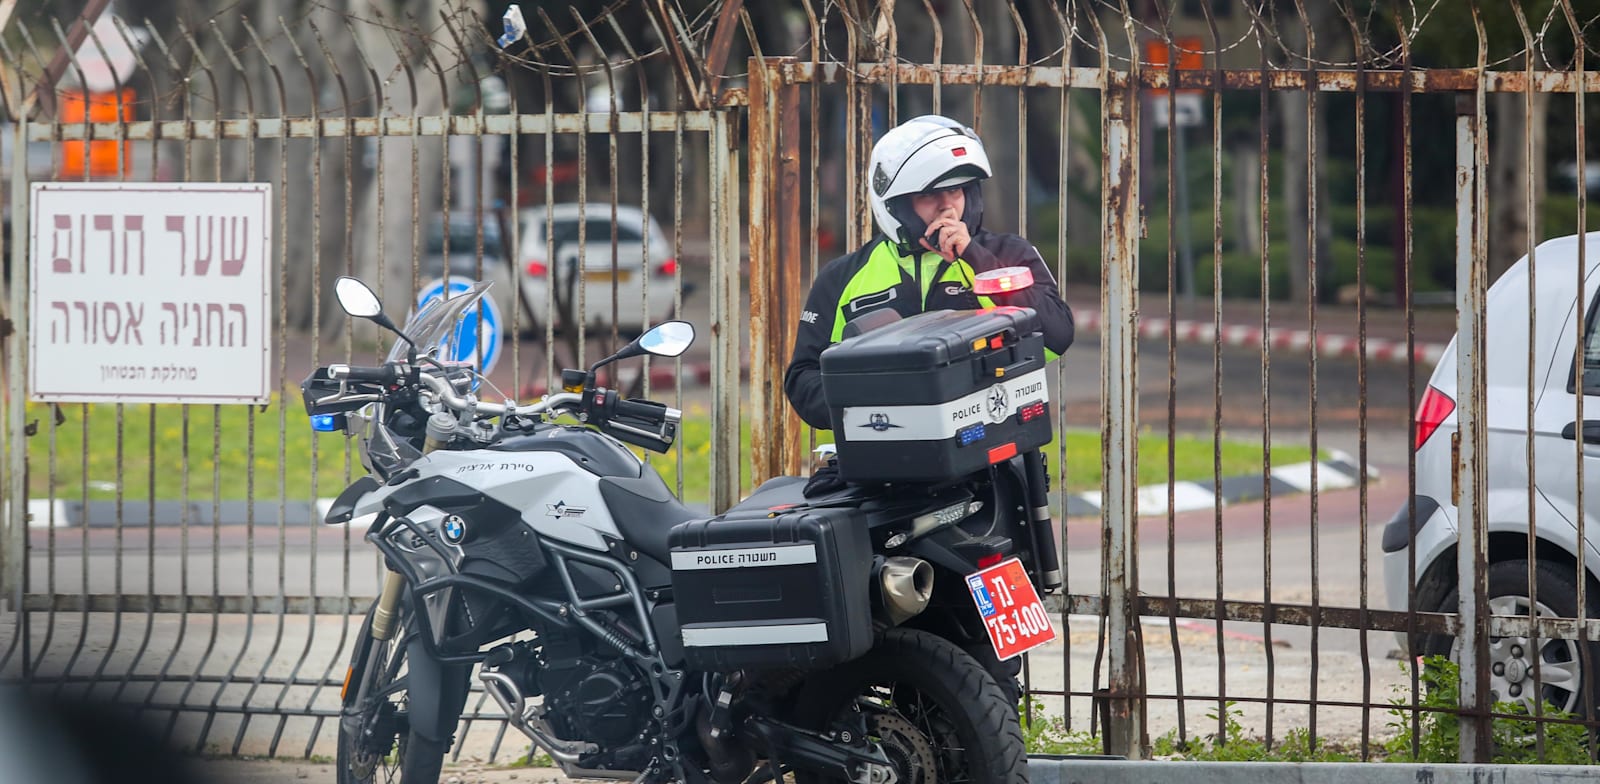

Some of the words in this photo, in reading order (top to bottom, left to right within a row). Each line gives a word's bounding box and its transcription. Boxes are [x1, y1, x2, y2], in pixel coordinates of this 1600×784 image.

[51, 214, 145, 275] חרום
[165, 215, 248, 276] שער
[51, 301, 144, 345] אסורה
[160, 302, 247, 347] החניה
[100, 364, 146, 383] הבטחון
[151, 363, 198, 383] מחלקת
[952, 403, 982, 422] POLICE
[1015, 382, 1042, 399] משטרה
[456, 463, 495, 474] ארצית
[500, 463, 534, 472] סיירת
[697, 554, 734, 565] POLICE
[738, 552, 777, 563] משטרה
